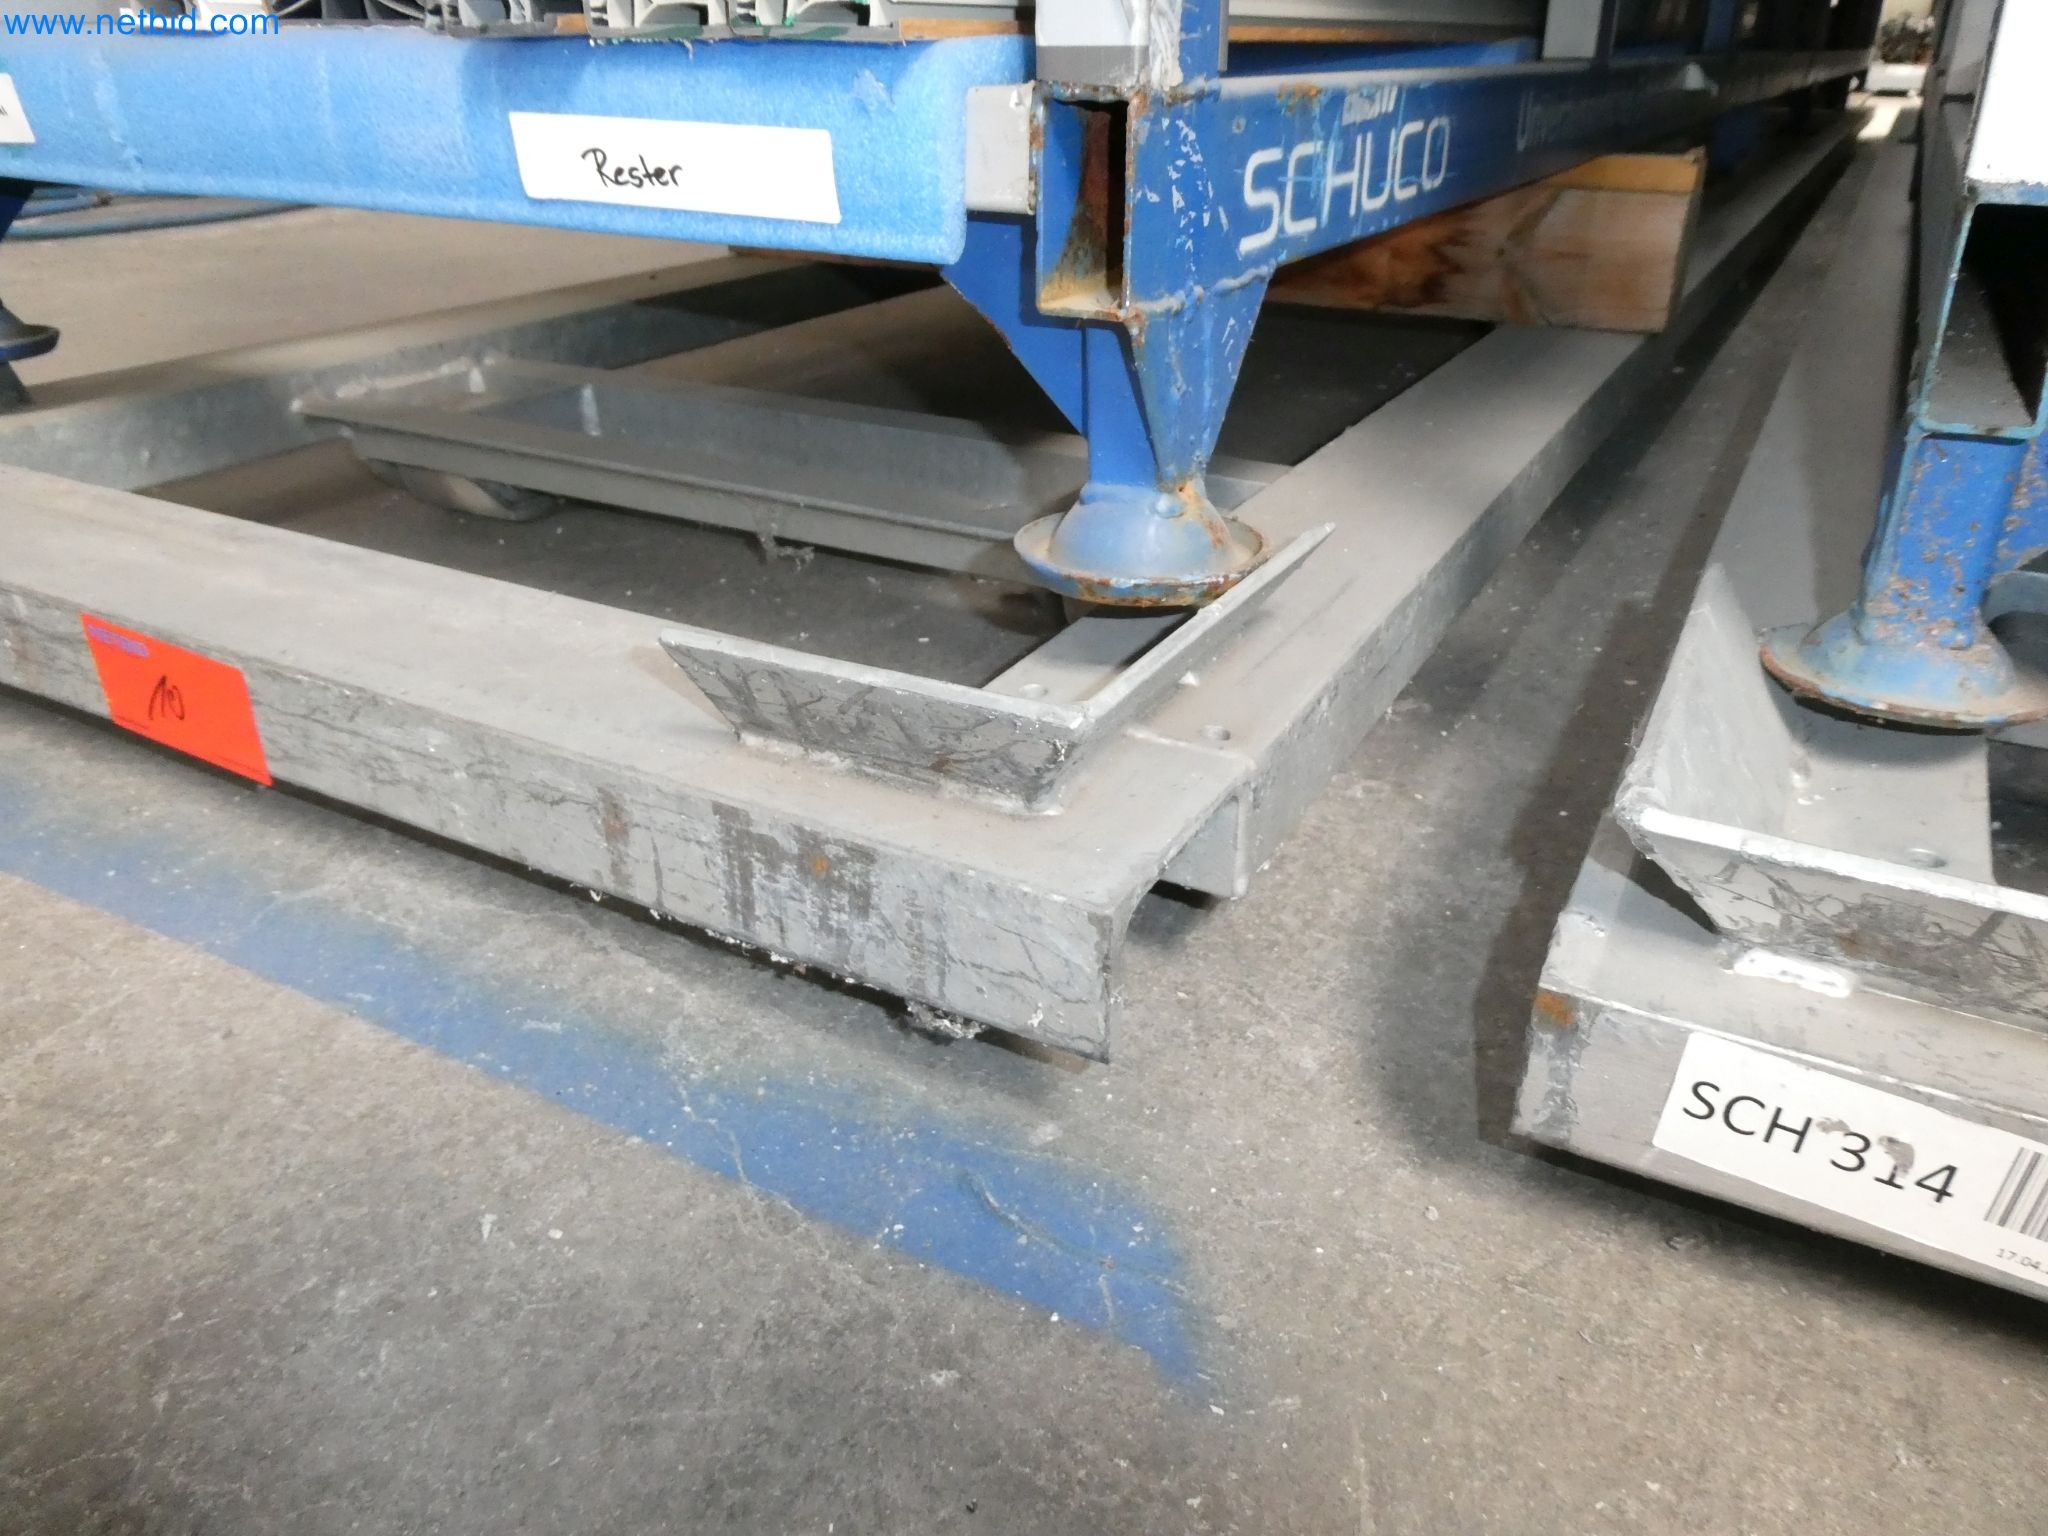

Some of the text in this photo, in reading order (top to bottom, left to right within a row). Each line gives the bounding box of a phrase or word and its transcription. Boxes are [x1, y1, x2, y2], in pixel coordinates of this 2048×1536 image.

[581, 147, 683, 189] Rester
[1682, 1080, 1958, 1203] SCH 314
[1995, 1247, 2048, 1276] 17.04.
